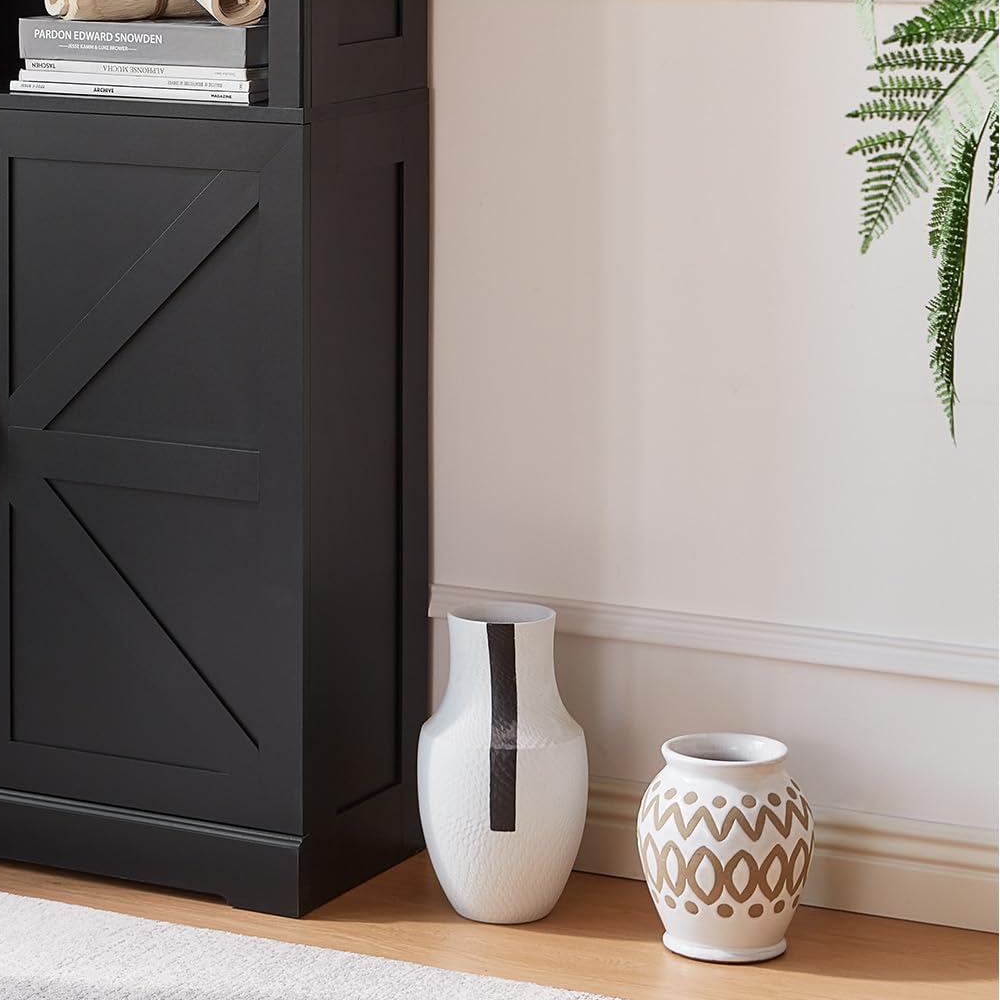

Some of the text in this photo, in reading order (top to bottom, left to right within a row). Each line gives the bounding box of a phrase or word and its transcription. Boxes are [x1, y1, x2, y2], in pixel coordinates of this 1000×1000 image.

[34, 28, 163, 44] PARDON EDWARD SNOWDEN
[102, 64, 165, 74] ALPHONSE MUCHA
